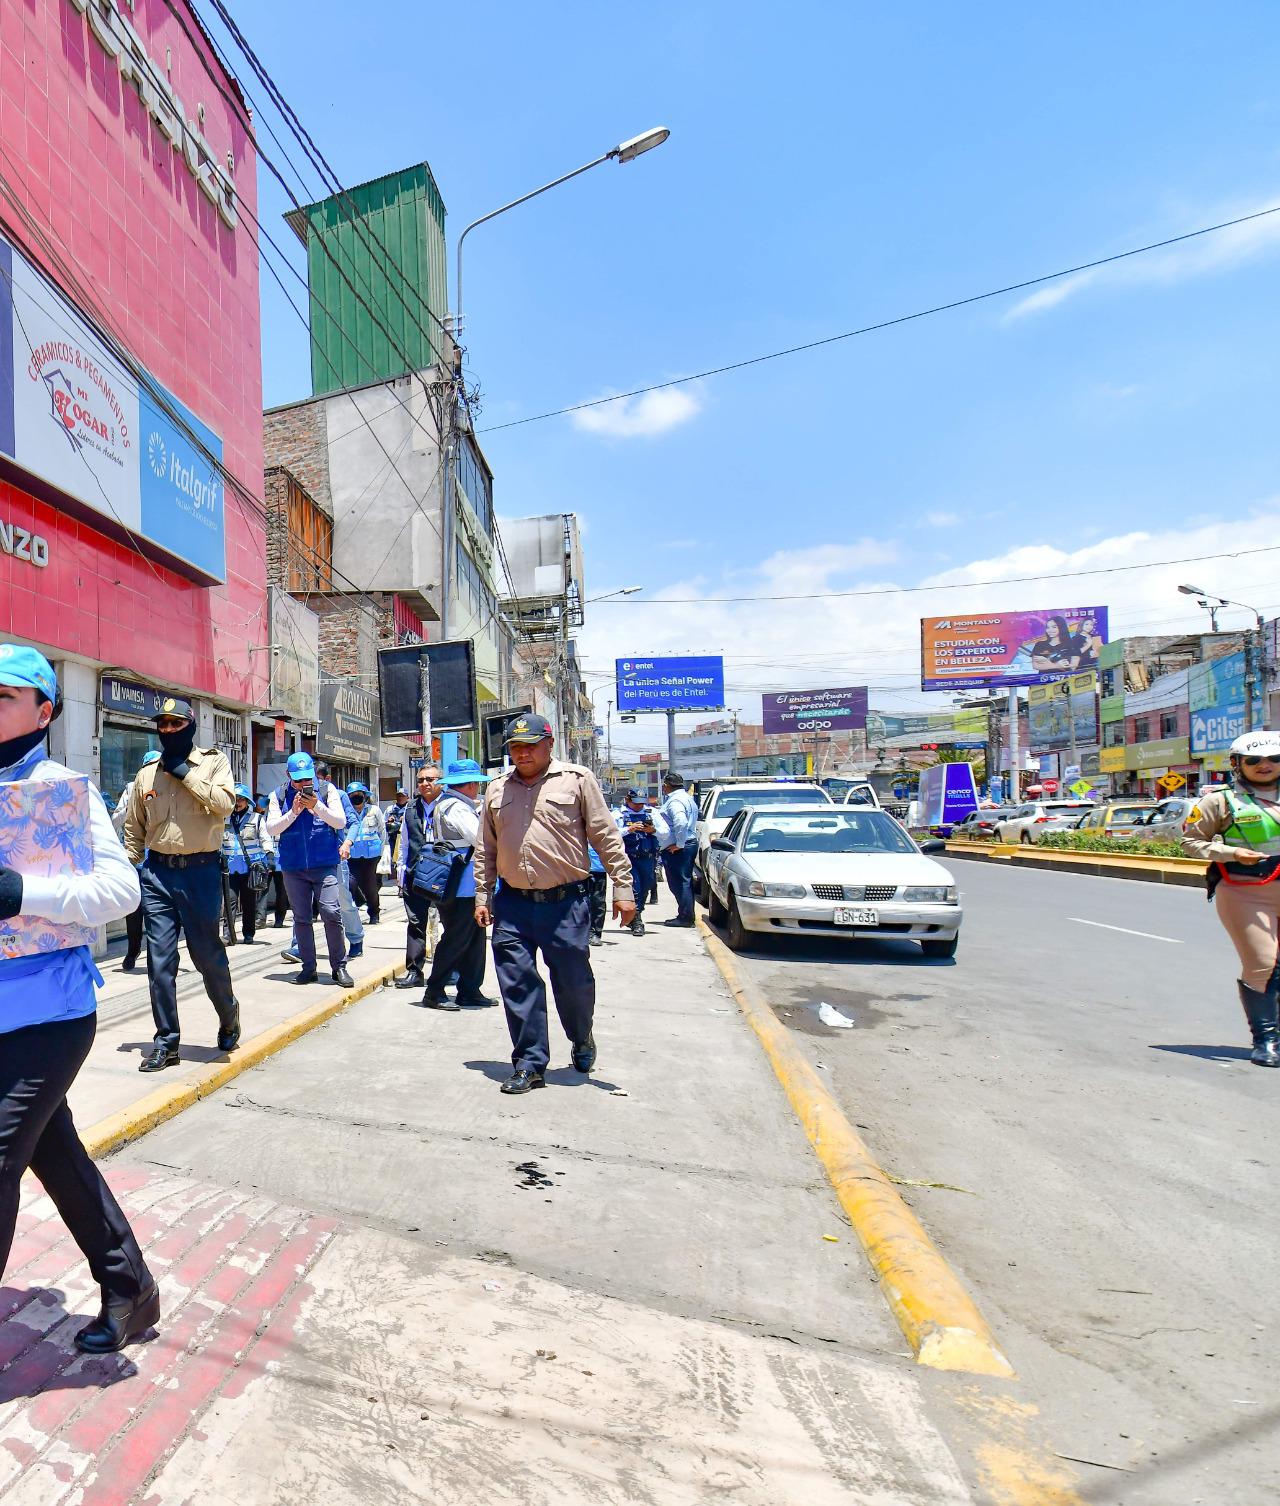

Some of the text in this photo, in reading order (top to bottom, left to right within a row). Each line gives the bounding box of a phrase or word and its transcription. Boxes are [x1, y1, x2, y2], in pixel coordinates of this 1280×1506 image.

[77, 387, 88, 401] MI
[84, 357, 131, 448] PEGAMENTOS
[170, 451, 218, 512] Italgrif
[954, 619, 1001, 627] MONTALVO
[934, 637, 1000, 648] ESTUDIA CON
[934, 646, 1006, 657] LOS EXPERTOS
[935, 657, 992, 666] EN BELLEZA
[661, 676, 685, 685] Señal
[686, 677, 714, 685] Power
[121, 686, 145, 704] VAINSA
[624, 690, 636, 698] del
[639, 689, 658, 698] Perú
[672, 689, 682, 697] de
[684, 688, 708, 697] Entel.
[814, 692, 853, 702] software
[789, 700, 841, 711] empresarial
[781, 713, 795, 721] que
[798, 720, 832, 730] odoo
